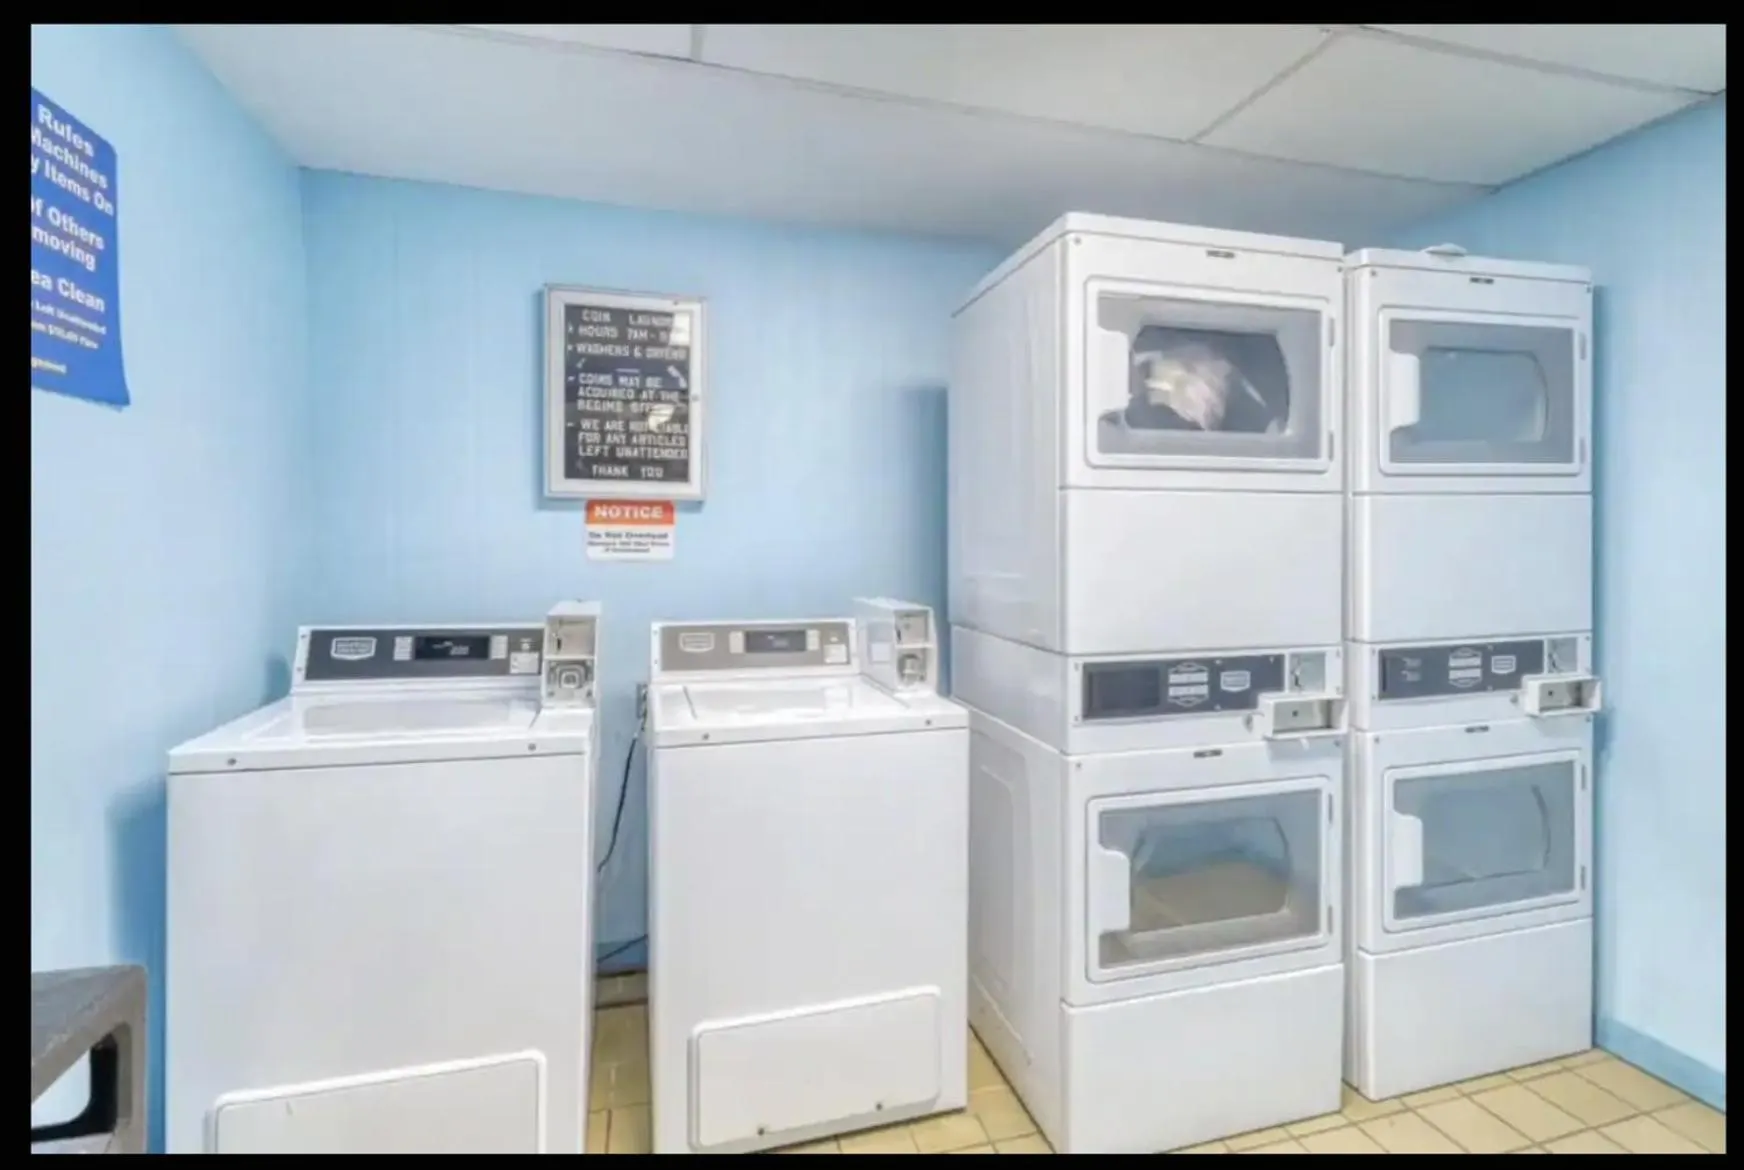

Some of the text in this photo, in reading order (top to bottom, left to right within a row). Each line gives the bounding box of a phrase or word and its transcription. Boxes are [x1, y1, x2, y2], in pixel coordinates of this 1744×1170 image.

[38, 103, 94, 157] Rules
[45, 159, 91, 203] Items
[93, 190, 115, 217] On
[47, 206, 105, 250] Others
[58, 277, 105, 313] Clean
[582, 309, 611, 322] COIN
[578, 325, 618, 339] HOURS
[627, 328, 648, 341] 7AM
[575, 343, 630, 357] WASHERS
[633, 346, 642, 359] &
[579, 372, 612, 386] COINS
[618, 376, 640, 388] MAY
[577, 386, 635, 399] ACQUIRED
[640, 388, 657, 400] AT
[579, 418, 600, 431] WE
[603, 419, 625, 432] ARE
[578, 432, 686, 447] FOR ANY ARTICLES
[578, 445, 609, 457] LEFT
[591, 464, 664, 479] THANK YOU
[593, 504, 664, 520] NOTICE
